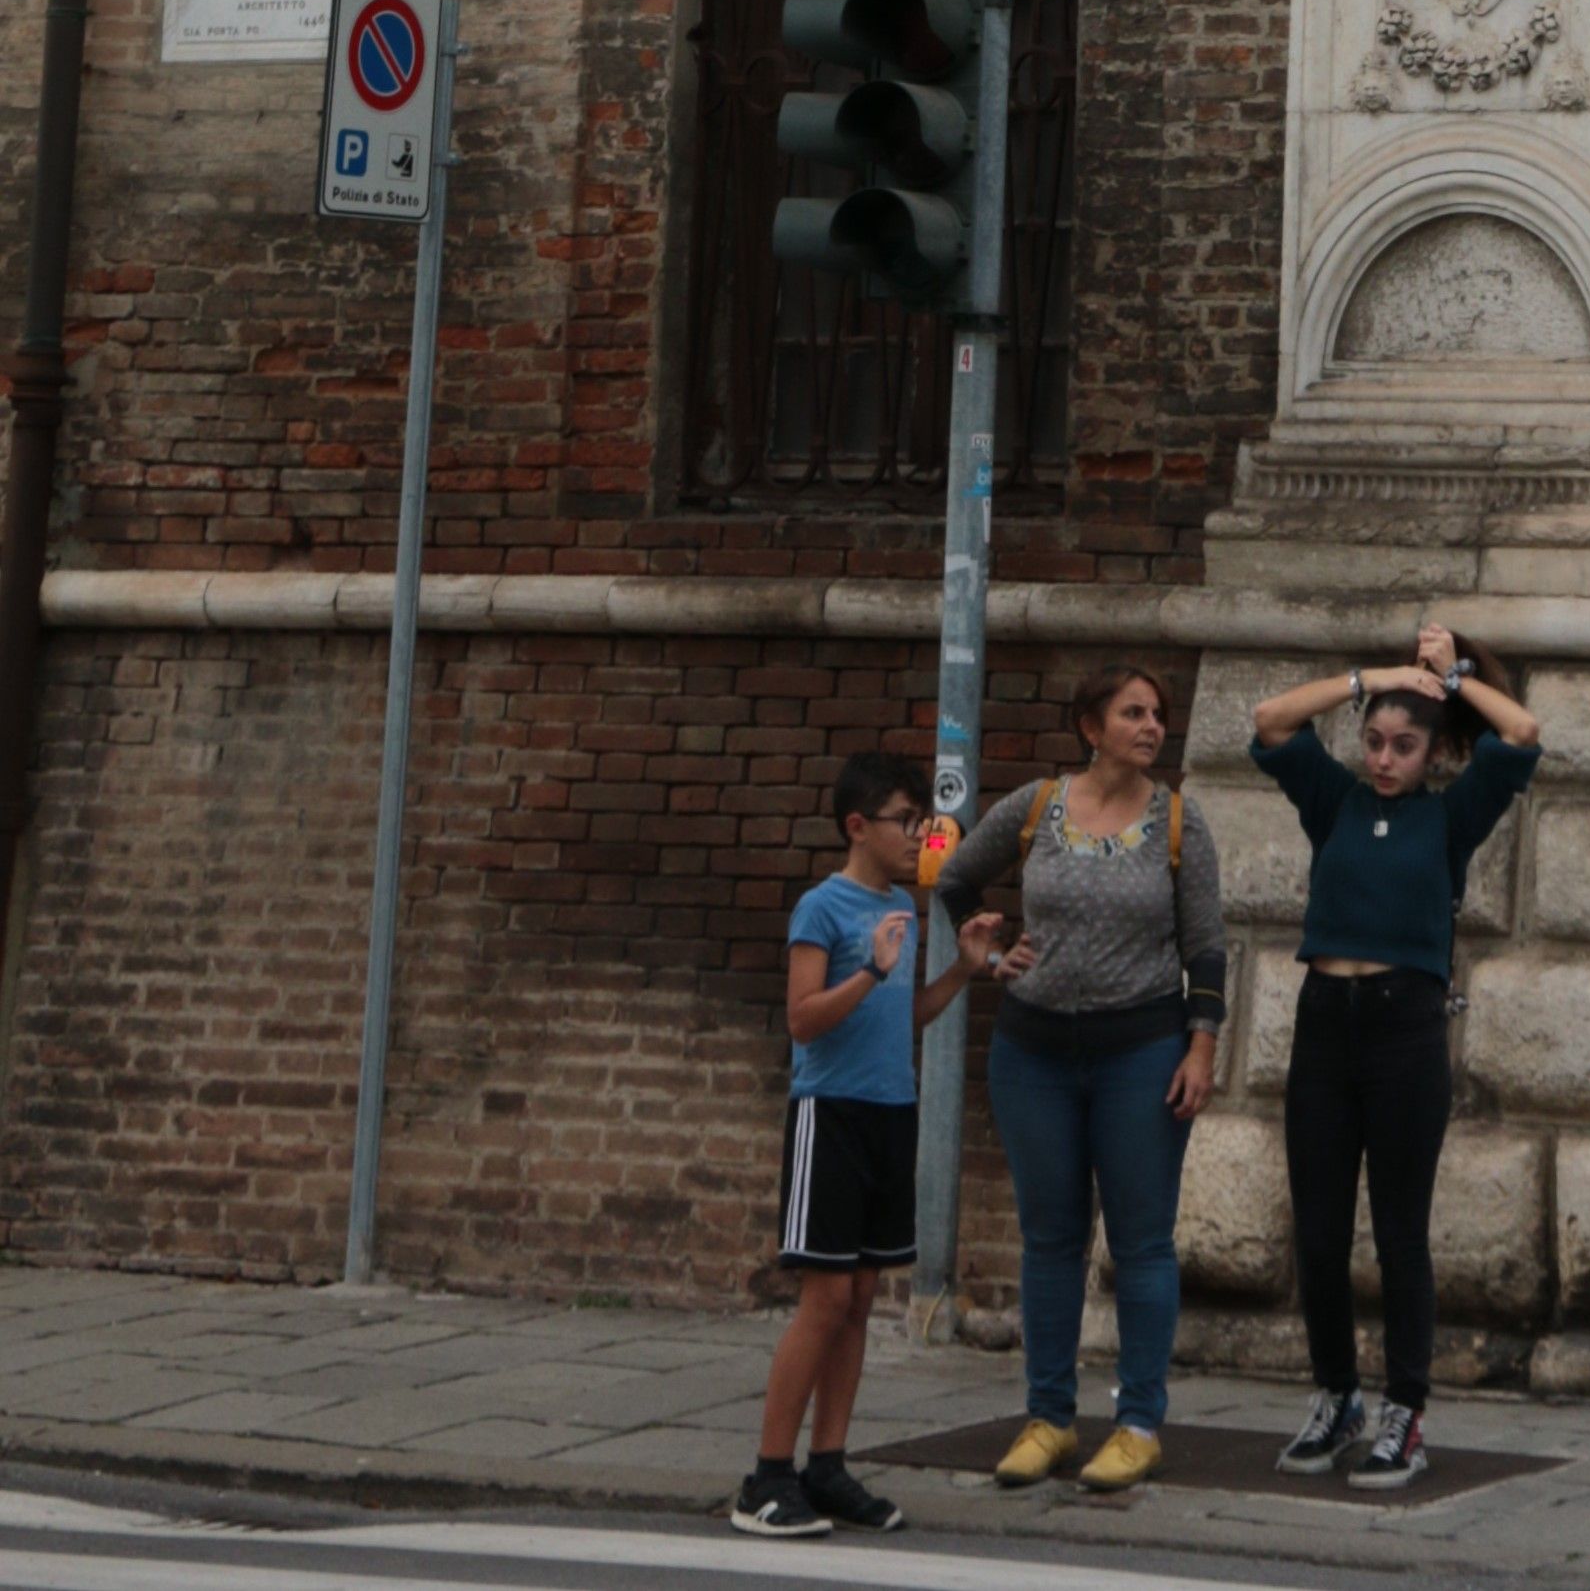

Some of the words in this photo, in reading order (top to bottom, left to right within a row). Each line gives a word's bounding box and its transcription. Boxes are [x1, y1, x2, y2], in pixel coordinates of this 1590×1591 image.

[237, 0, 306, 12] ARCHITETTO
[342, 135, 363, 170] P
[332, 185, 369, 202] Polizia
[372, 190, 383, 203] di
[386, 190, 420, 208] Stato
[961, 347, 970, 370] 4
